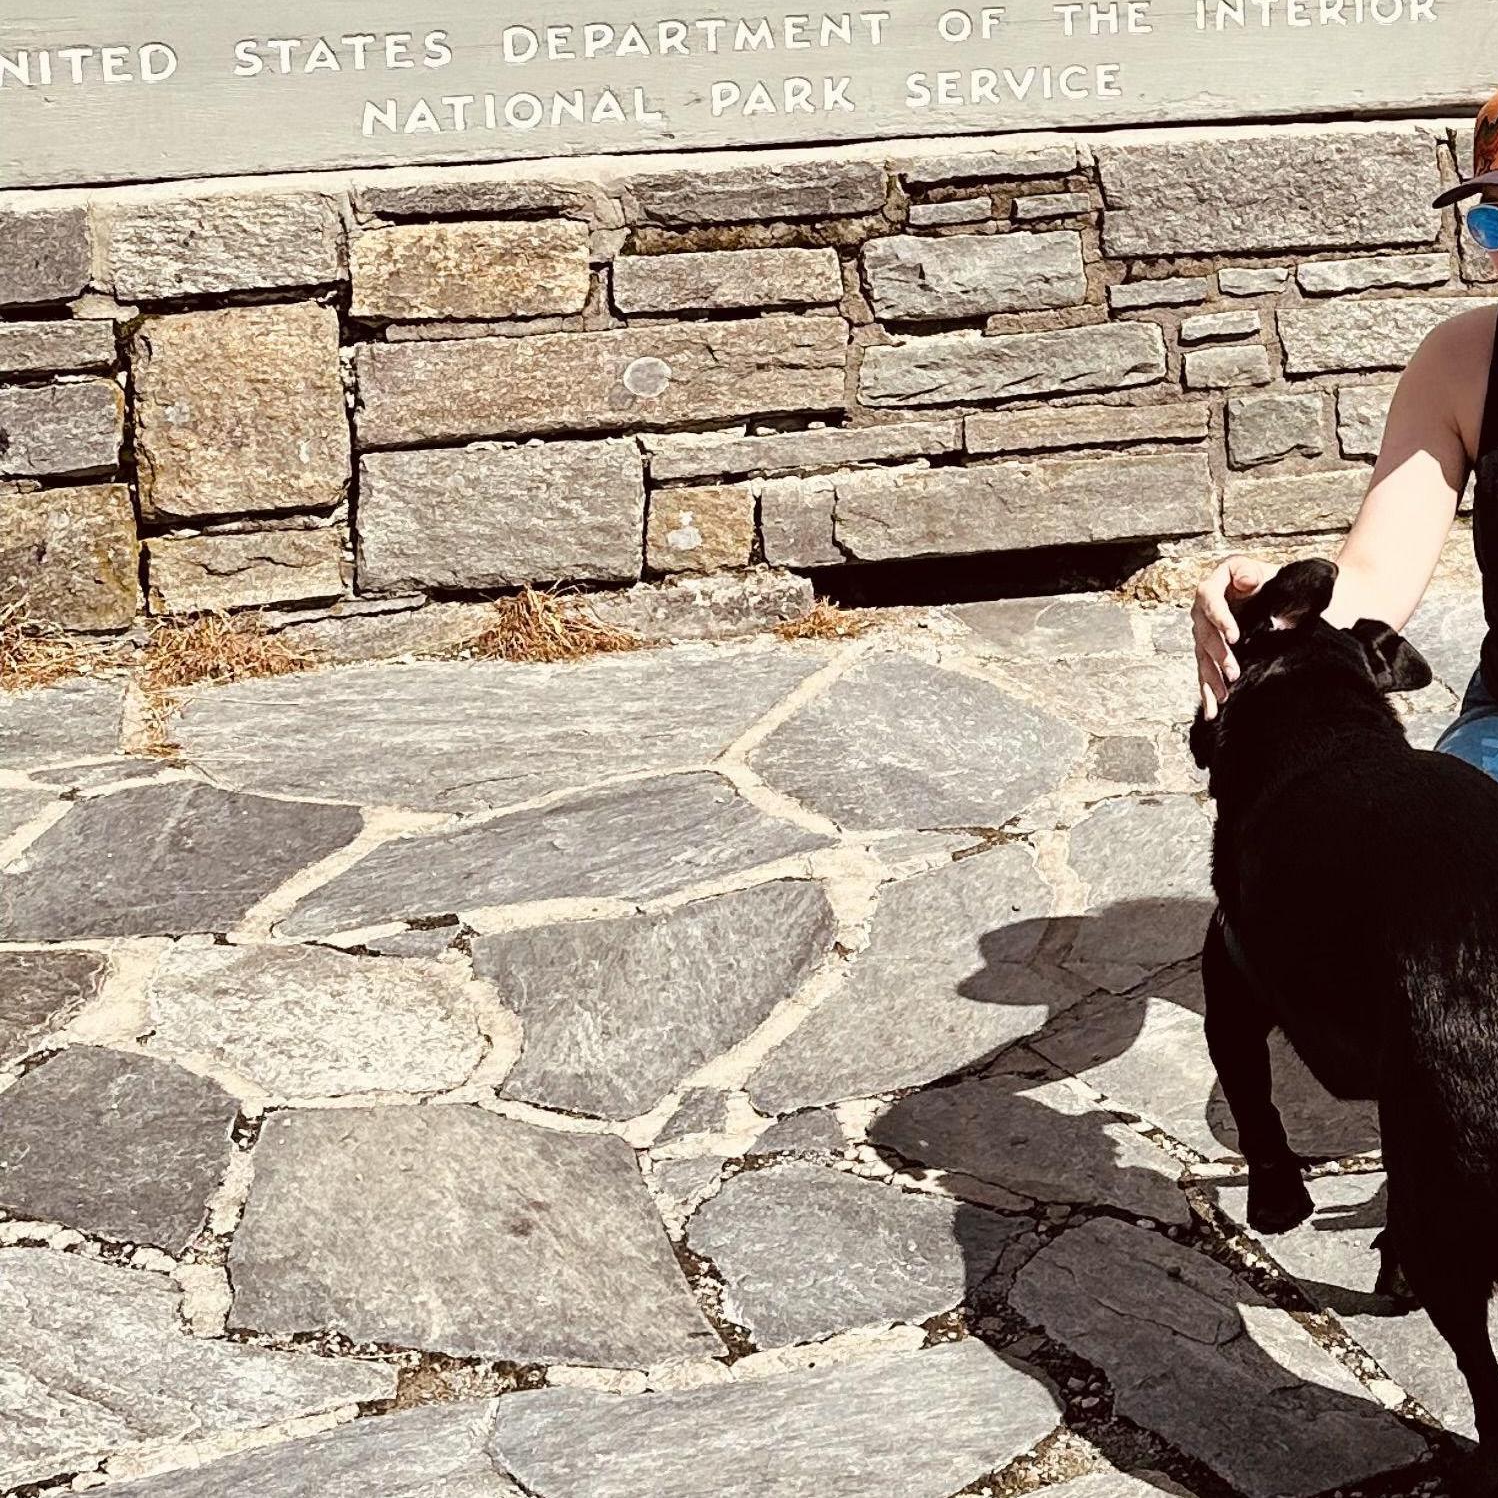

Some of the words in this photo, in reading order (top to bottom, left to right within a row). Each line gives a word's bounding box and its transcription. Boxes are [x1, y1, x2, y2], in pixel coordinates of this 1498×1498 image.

[0, 42, 178, 87] NITED
[233, 29, 453, 77] STATES
[503, 11, 890, 64] DEPARTMENT
[938, 8, 1005, 43] OF
[1053, 1, 1153, 36] THE
[362, 86, 663, 135] NATIONAL
[711, 77, 855, 116] PARK
[905, 63, 1122, 107] SERVICE
